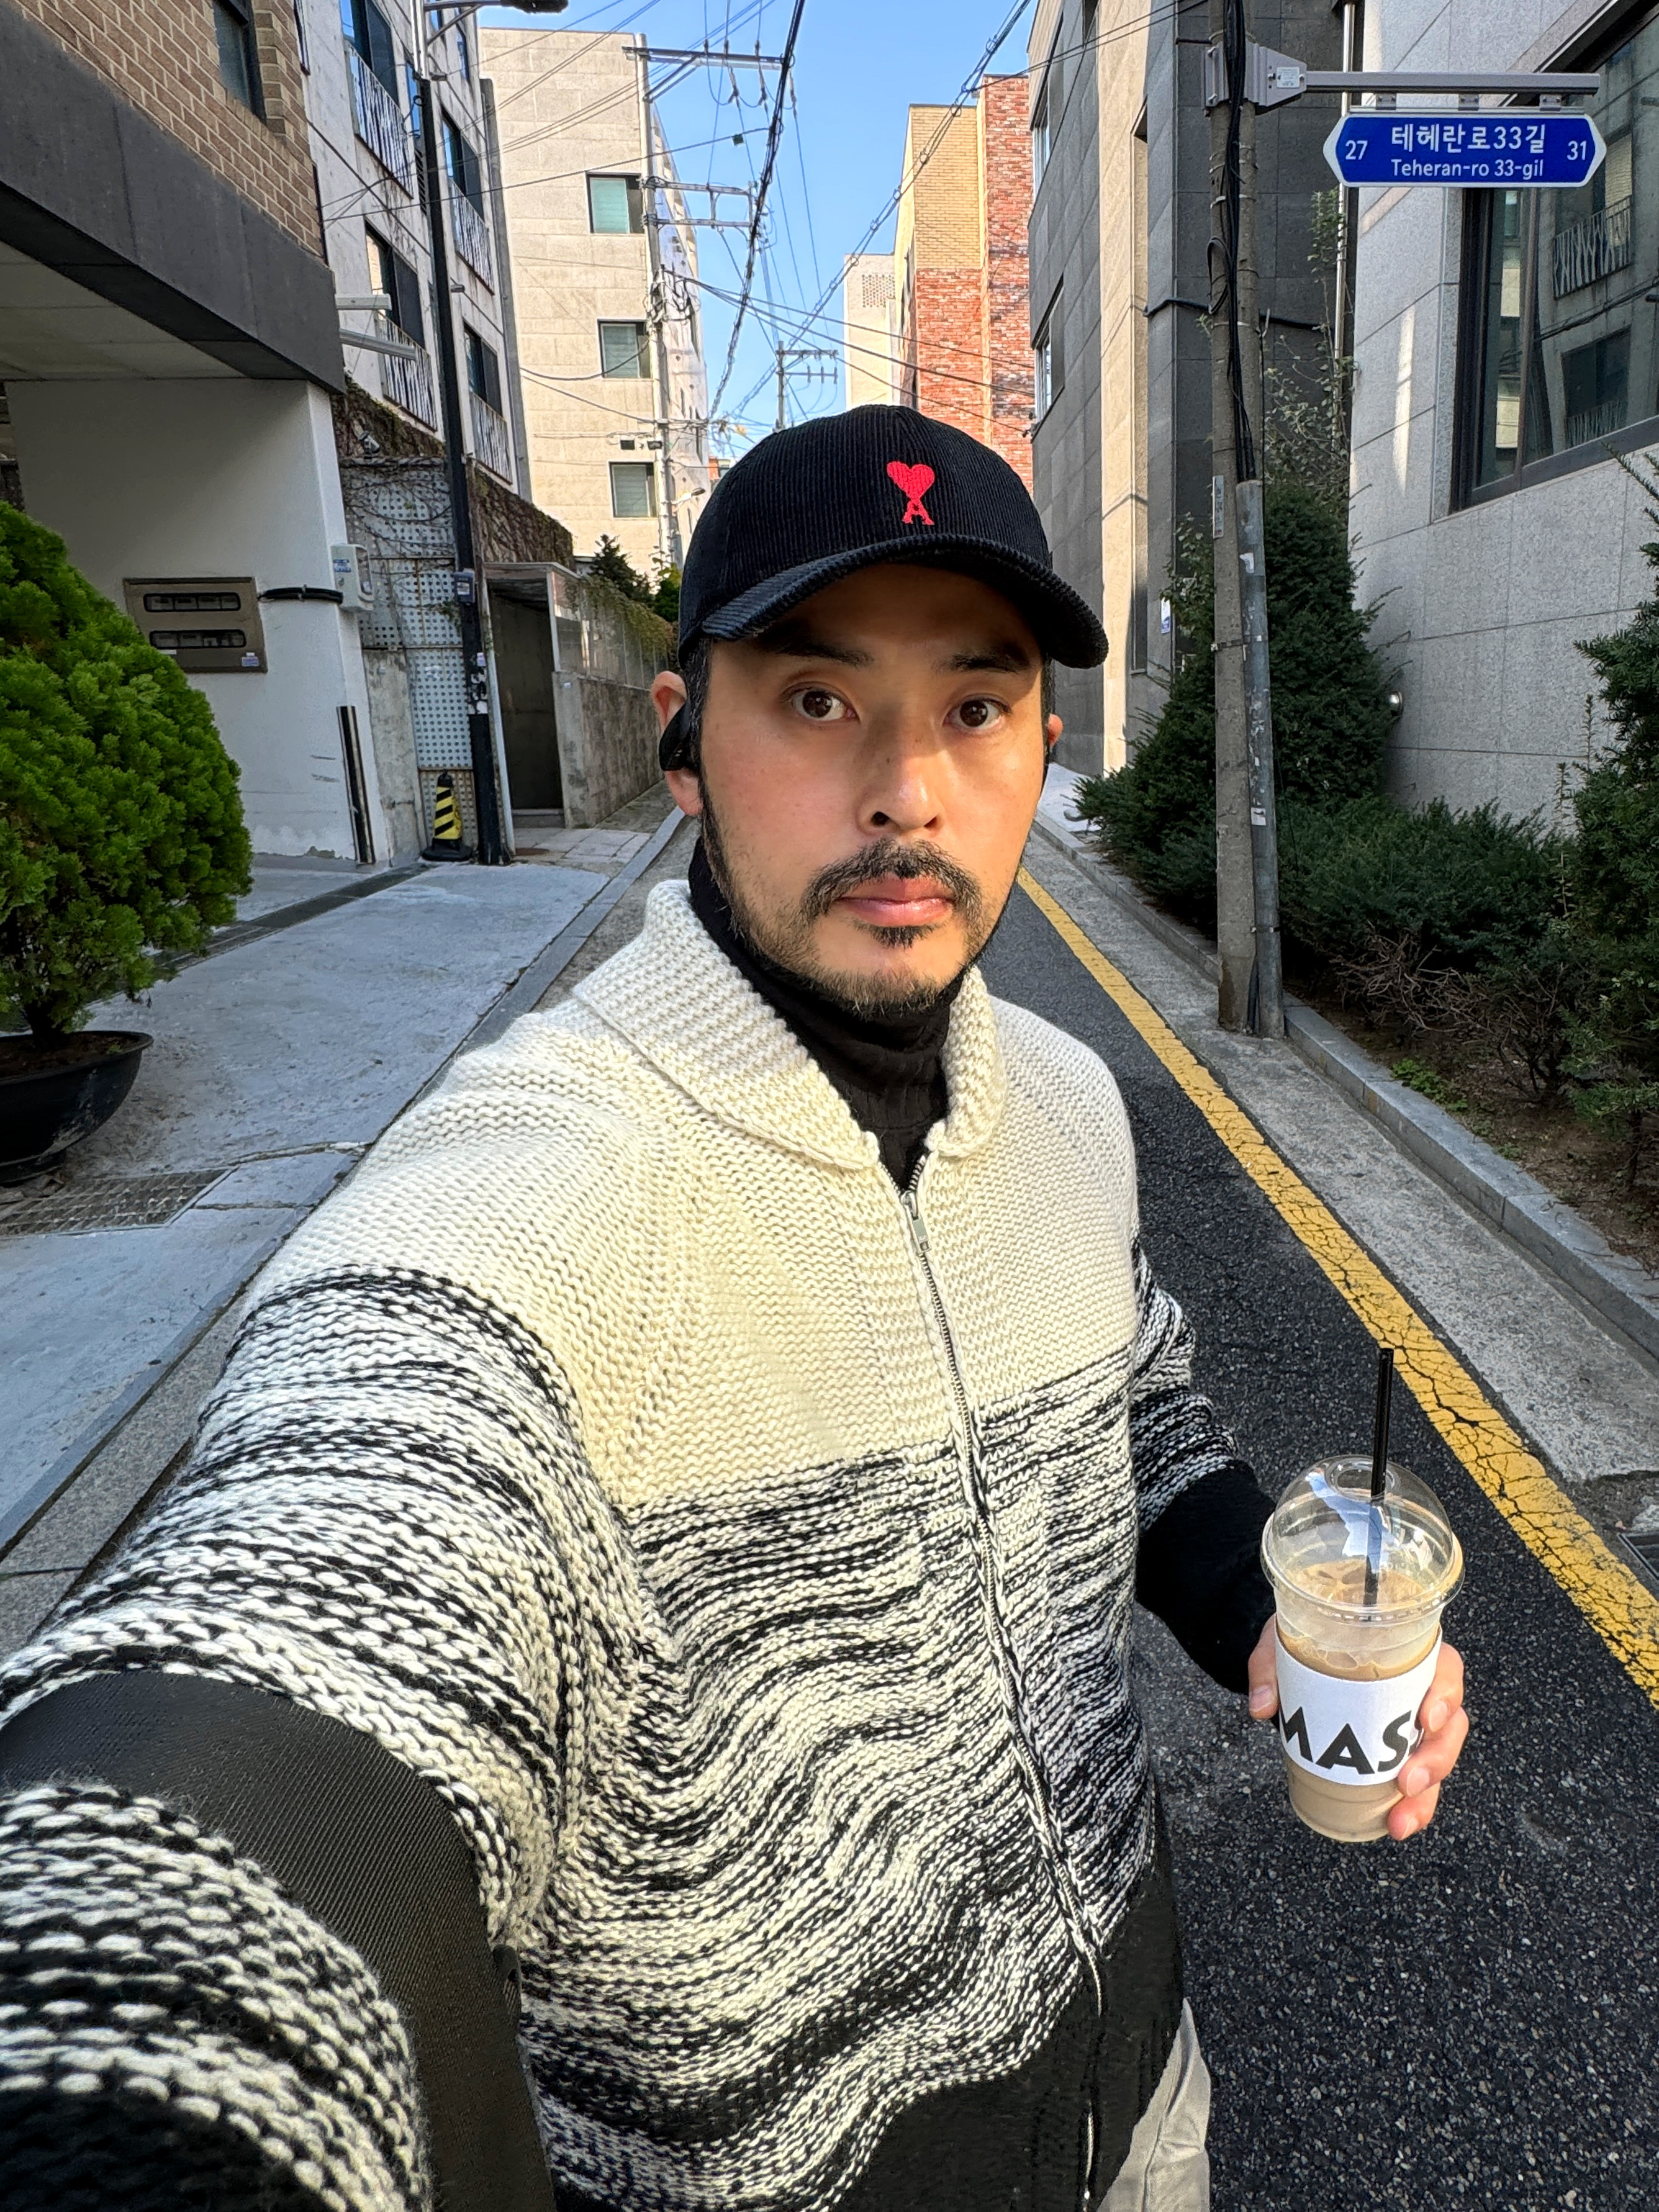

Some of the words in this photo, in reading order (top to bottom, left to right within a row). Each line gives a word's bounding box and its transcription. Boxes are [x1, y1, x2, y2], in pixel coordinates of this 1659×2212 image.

[1391, 124, 1545, 153] 테헤란로33길
[1345, 140, 1368, 160] 27
[1566, 140, 1587, 161] 31
[1391, 159, 1489, 176] Teheran-ro
[1494, 159, 1544, 180] 33-gil
[1279, 1700, 1423, 1775] MAS
